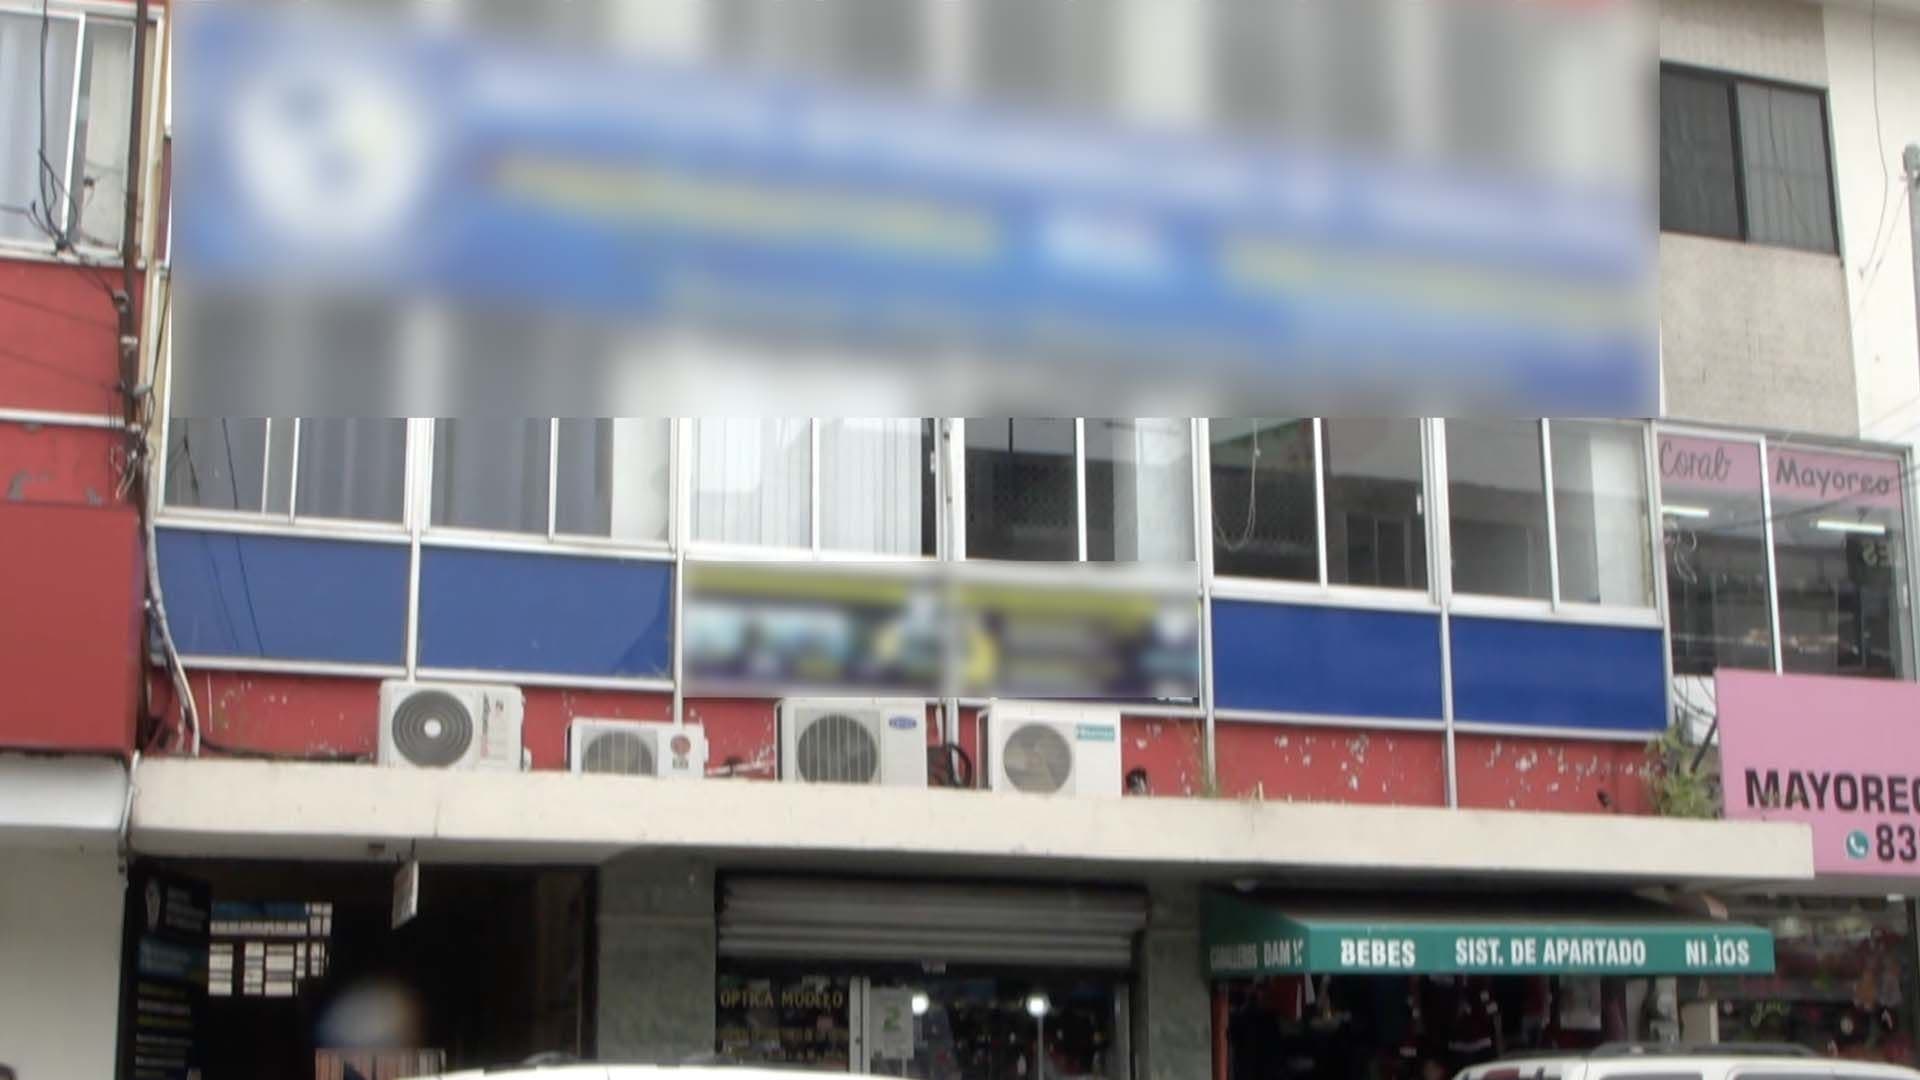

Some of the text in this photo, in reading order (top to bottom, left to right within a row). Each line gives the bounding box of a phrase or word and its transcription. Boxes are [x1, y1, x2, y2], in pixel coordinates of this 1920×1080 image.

[1660, 441, 1891, 496] Coral Mayoreo
[1876, 823, 1920, 862] 83
[1340, 938, 1416, 968] BEBES
[1455, 936, 1646, 967] SIST. DE APARTADO
